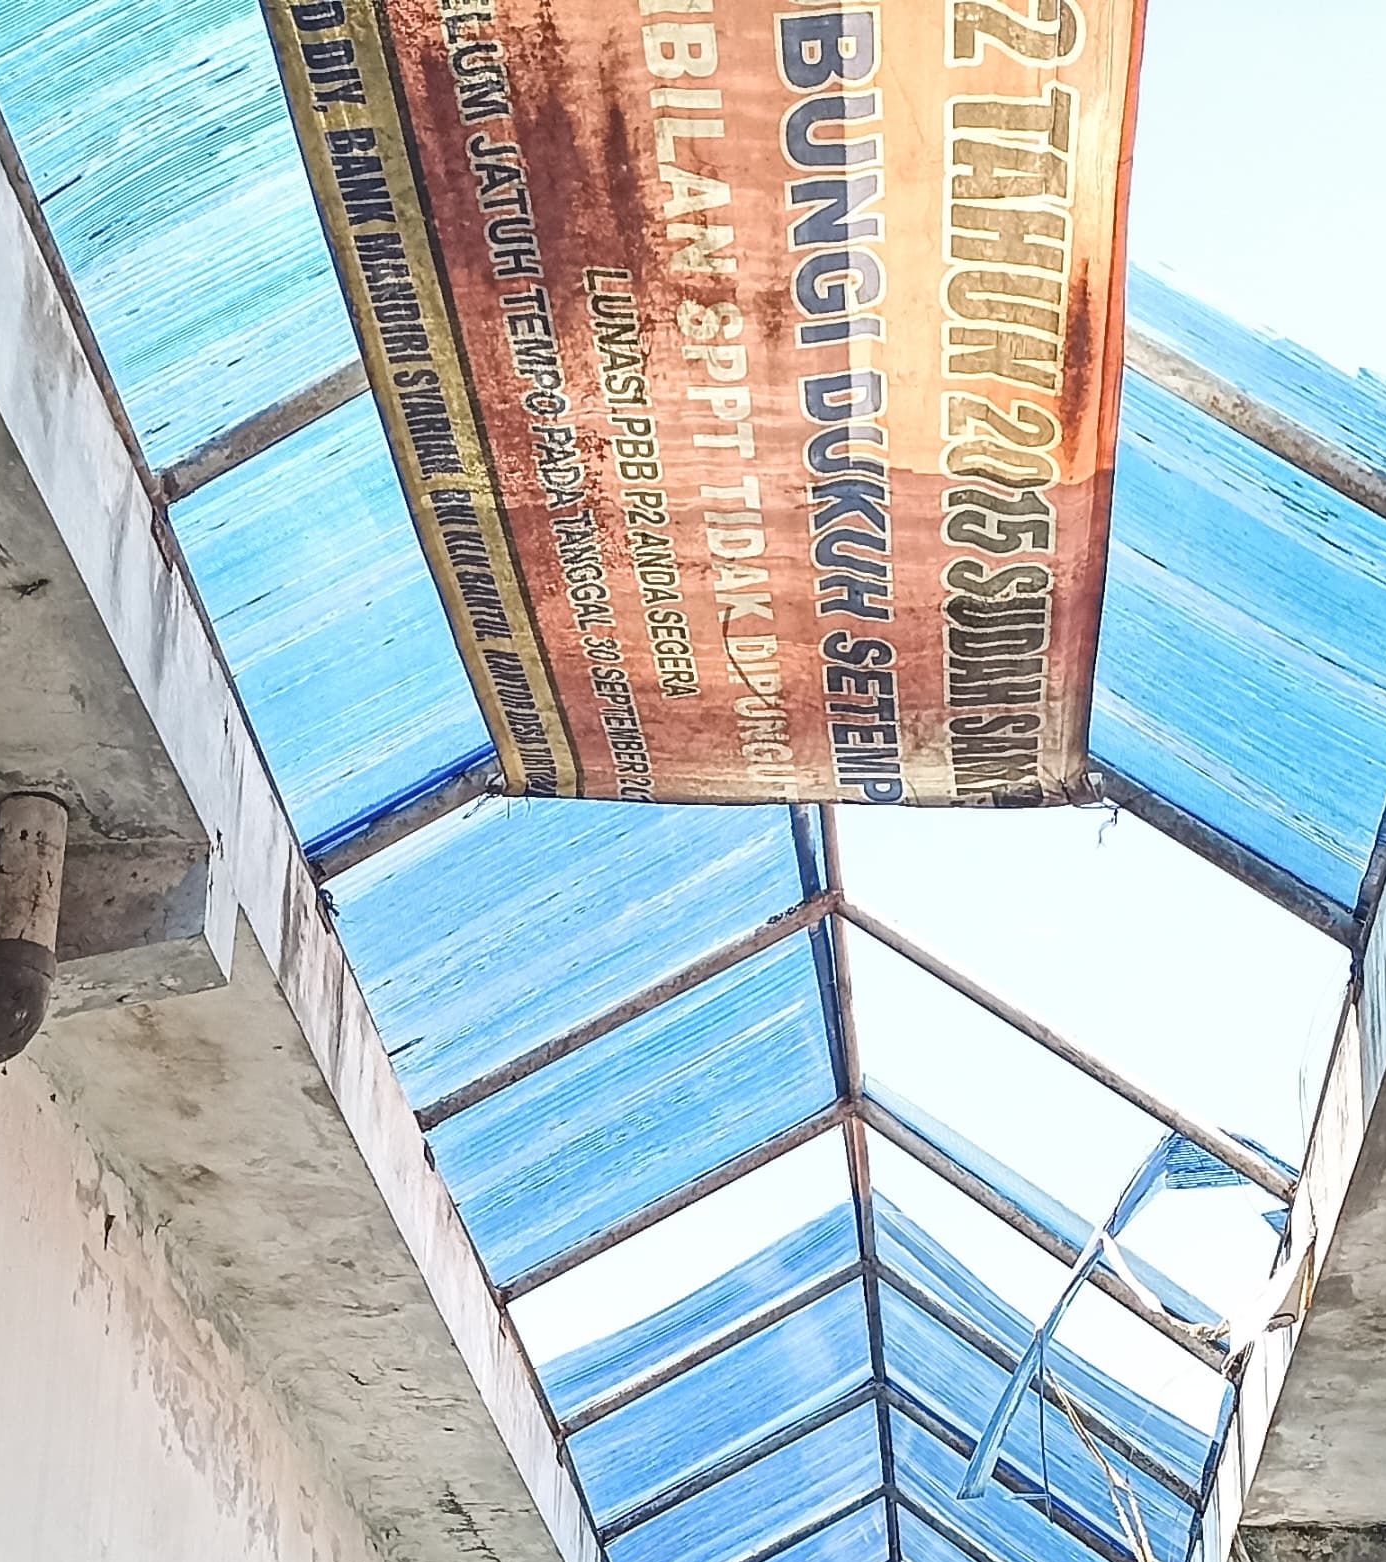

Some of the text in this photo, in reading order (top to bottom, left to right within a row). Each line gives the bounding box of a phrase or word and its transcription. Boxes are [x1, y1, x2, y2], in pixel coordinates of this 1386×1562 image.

[299, 39, 369, 114] DIY,
[324, 127, 398, 227] BANK
[466, 133, 542, 280] JATUH
[944, 87, 1075, 392] TAHUN
[353, 232, 433, 366] MANDIRI
[499, 287, 571, 418] TEMPO
[391, 369, 465, 482] SYARIAH,
[675, 299, 756, 457] SPPT
[776, 0, 903, 803] BUNGI DUKUH SETEMP
[428, 488, 481, 528] BNI
[531, 424, 587, 510] PADA
[583, 268, 701, 699] LUNASI PBB P2 ANDA SEGERA
[944, 395, 1059, 555] 2015
[447, 529, 492, 569] KLN
[455, 570, 514, 642] BANTUL,
[550, 509, 615, 633] TANGGAL
[699, 476, 775, 621] TIDAK
[481, 649, 536, 711] KANTOR
[582, 635, 624, 664] 30
[946, 561, 1051, 707] SUDAH
[504, 710, 550, 746] DESA
[587, 665, 653, 774] SEPTEMBER
